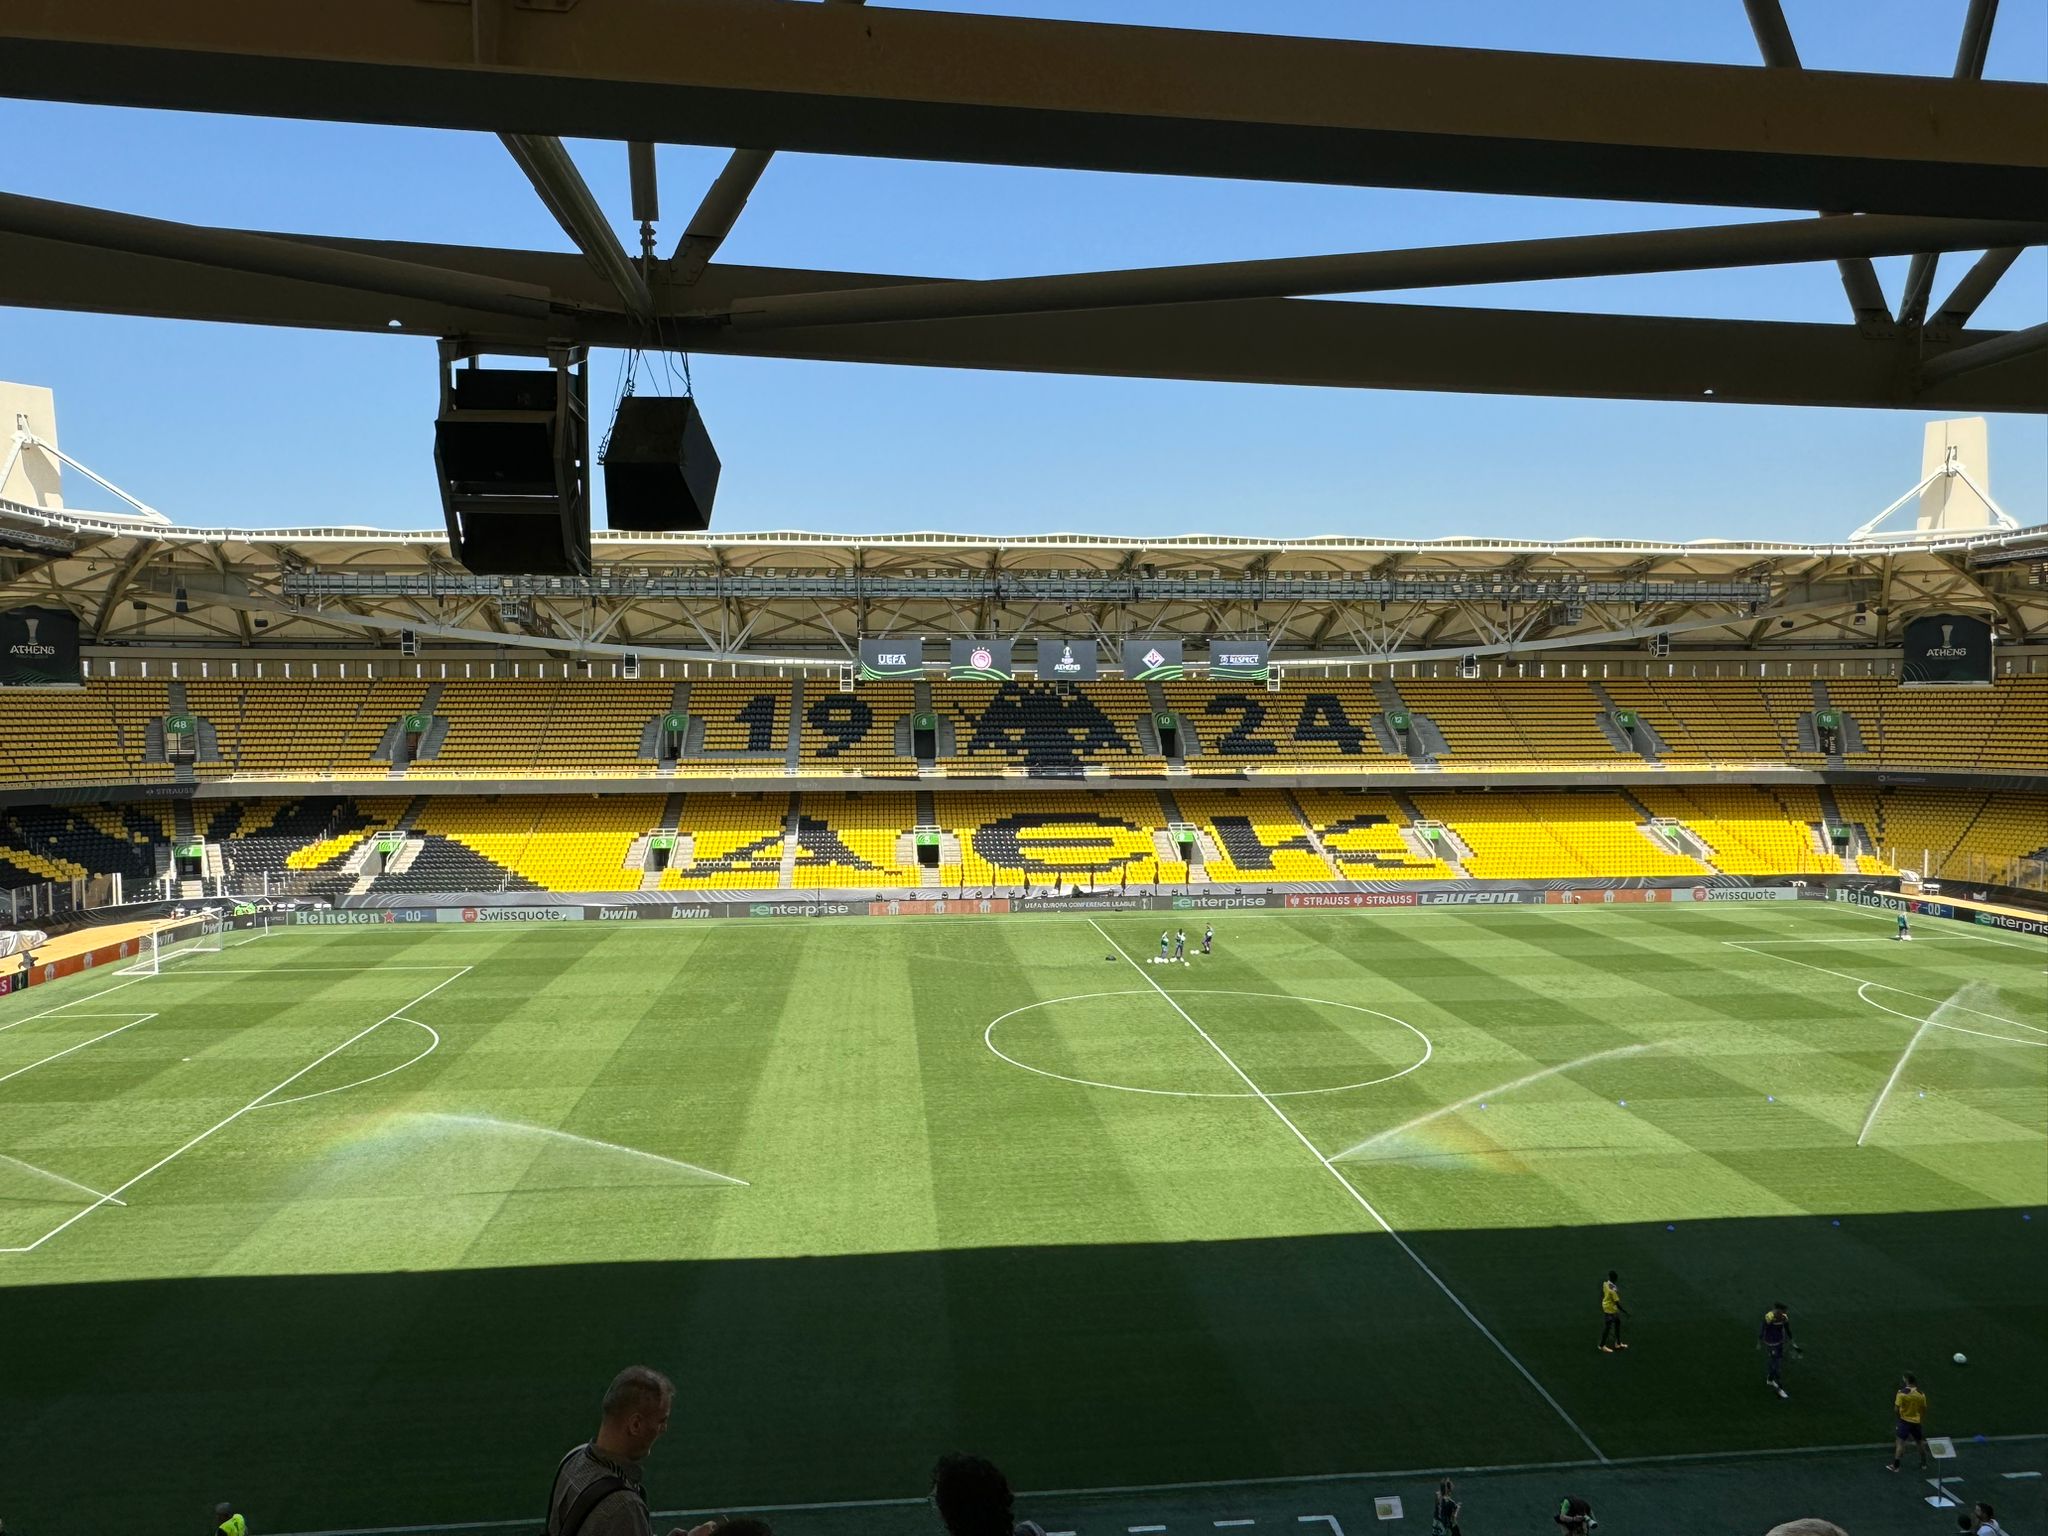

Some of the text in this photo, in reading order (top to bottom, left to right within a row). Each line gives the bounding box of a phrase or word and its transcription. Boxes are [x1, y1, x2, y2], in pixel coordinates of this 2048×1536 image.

[10, 645, 56, 655] ATHENS
[1926, 648, 1967, 657] ATHENS
[878, 654, 907, 665] UEFA
[1160, 716, 1170, 724] 10
[1394, 716, 1403, 724] 12
[1619, 715, 1629, 723] 14
[173, 721, 188, 729] 48
[180, 848, 194, 856] 47
[1708, 888, 1777, 901] Swissquote
[1835, 888, 1907, 912] Heineken
[1173, 895, 1266, 909] enterprise
[1303, 895, 1413, 906] STRAUSS STRAUSS
[480, 908, 560, 921] Swissquote
[599, 906, 638, 920] bwin
[671, 905, 710, 919] bwin
[750, 903, 849, 917] enterprise
[295, 910, 380, 925] Heineken
